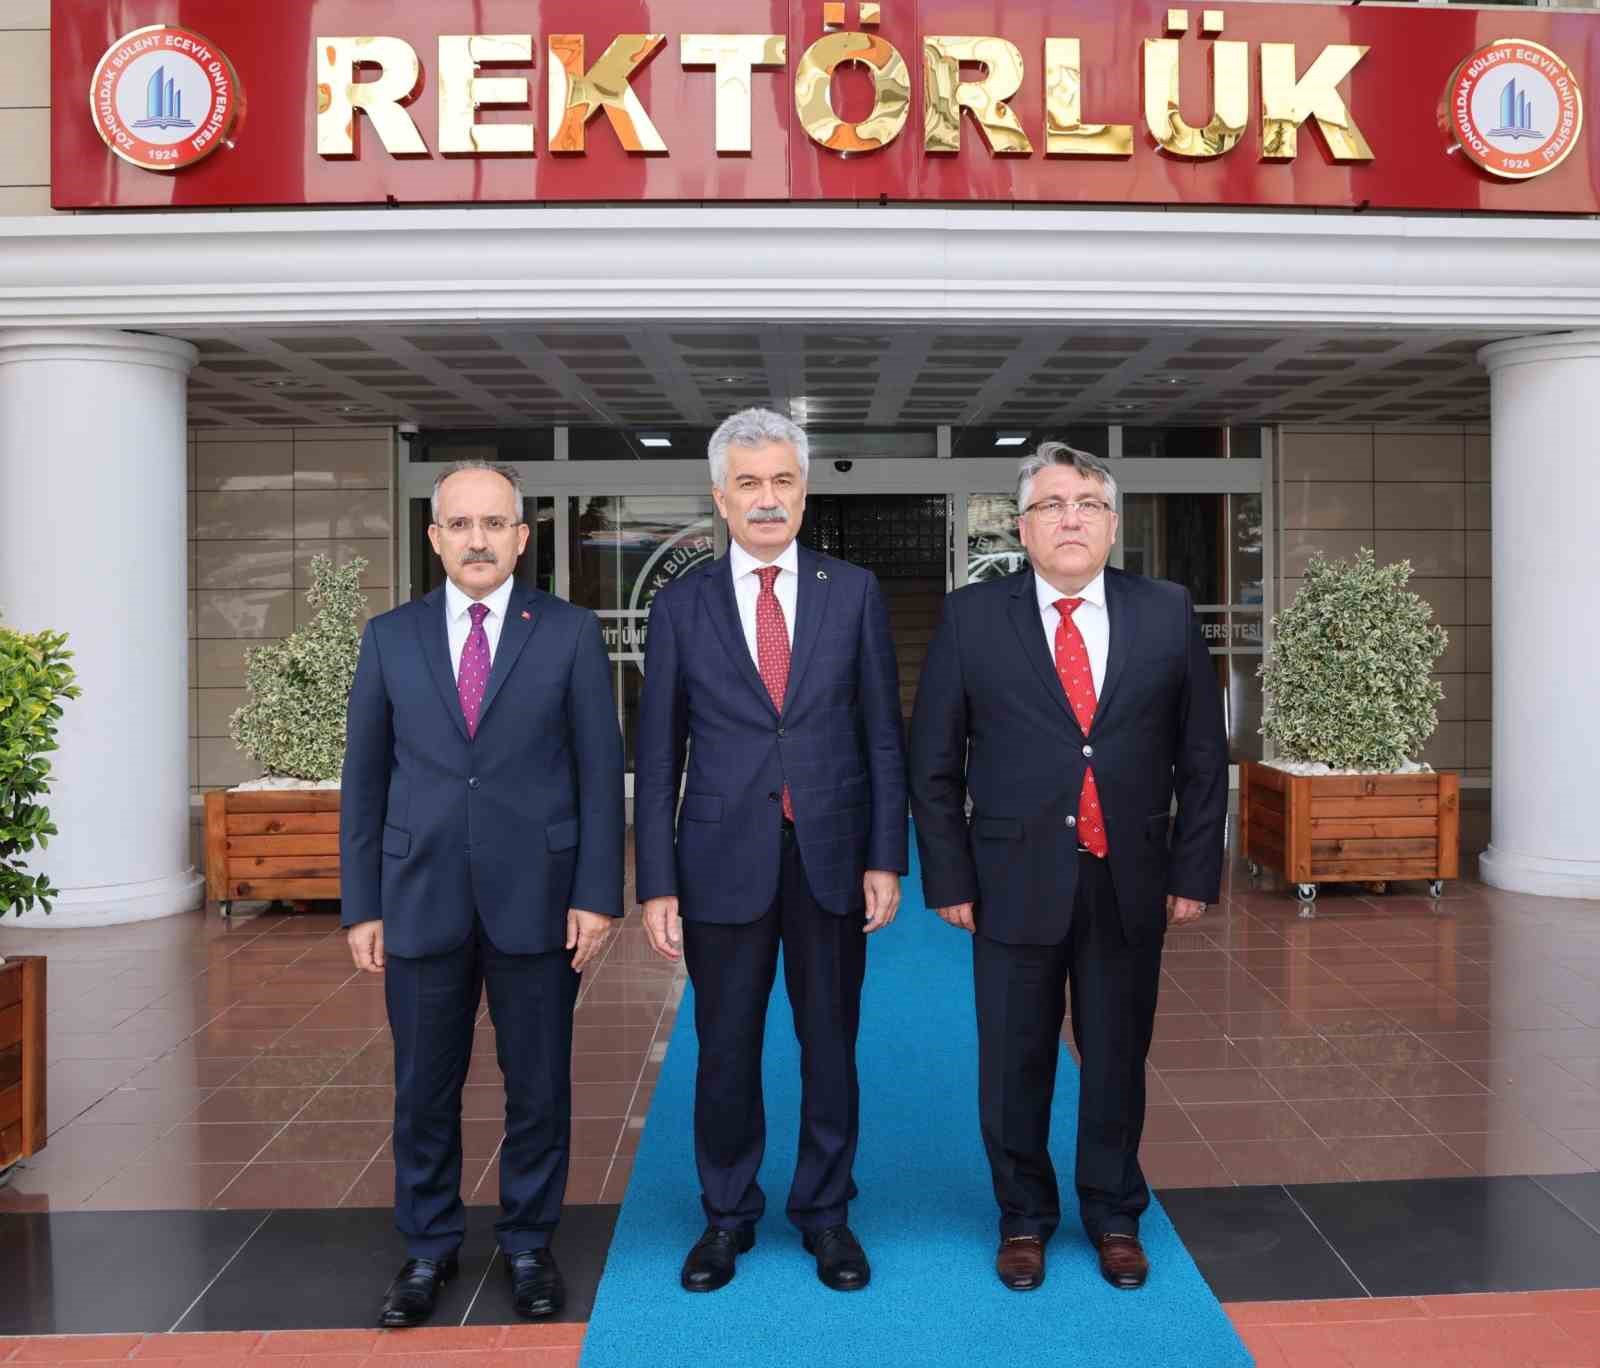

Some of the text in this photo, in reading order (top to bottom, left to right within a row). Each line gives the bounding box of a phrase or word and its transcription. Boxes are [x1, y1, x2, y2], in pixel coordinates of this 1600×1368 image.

[100, 35, 228, 152] ZONGULDAK BÜLENT ECEVİT ÜNİVERSİTESİ
[316, 2, 1374, 161] REKTÖRLÜK
[1456, 48, 1574, 161] ZONGULDAK BÜLENT ECEVİT ÜNİVERSİTESİ
[148, 148, 179, 160] 1924
[1503, 158, 1531, 169] 1924
